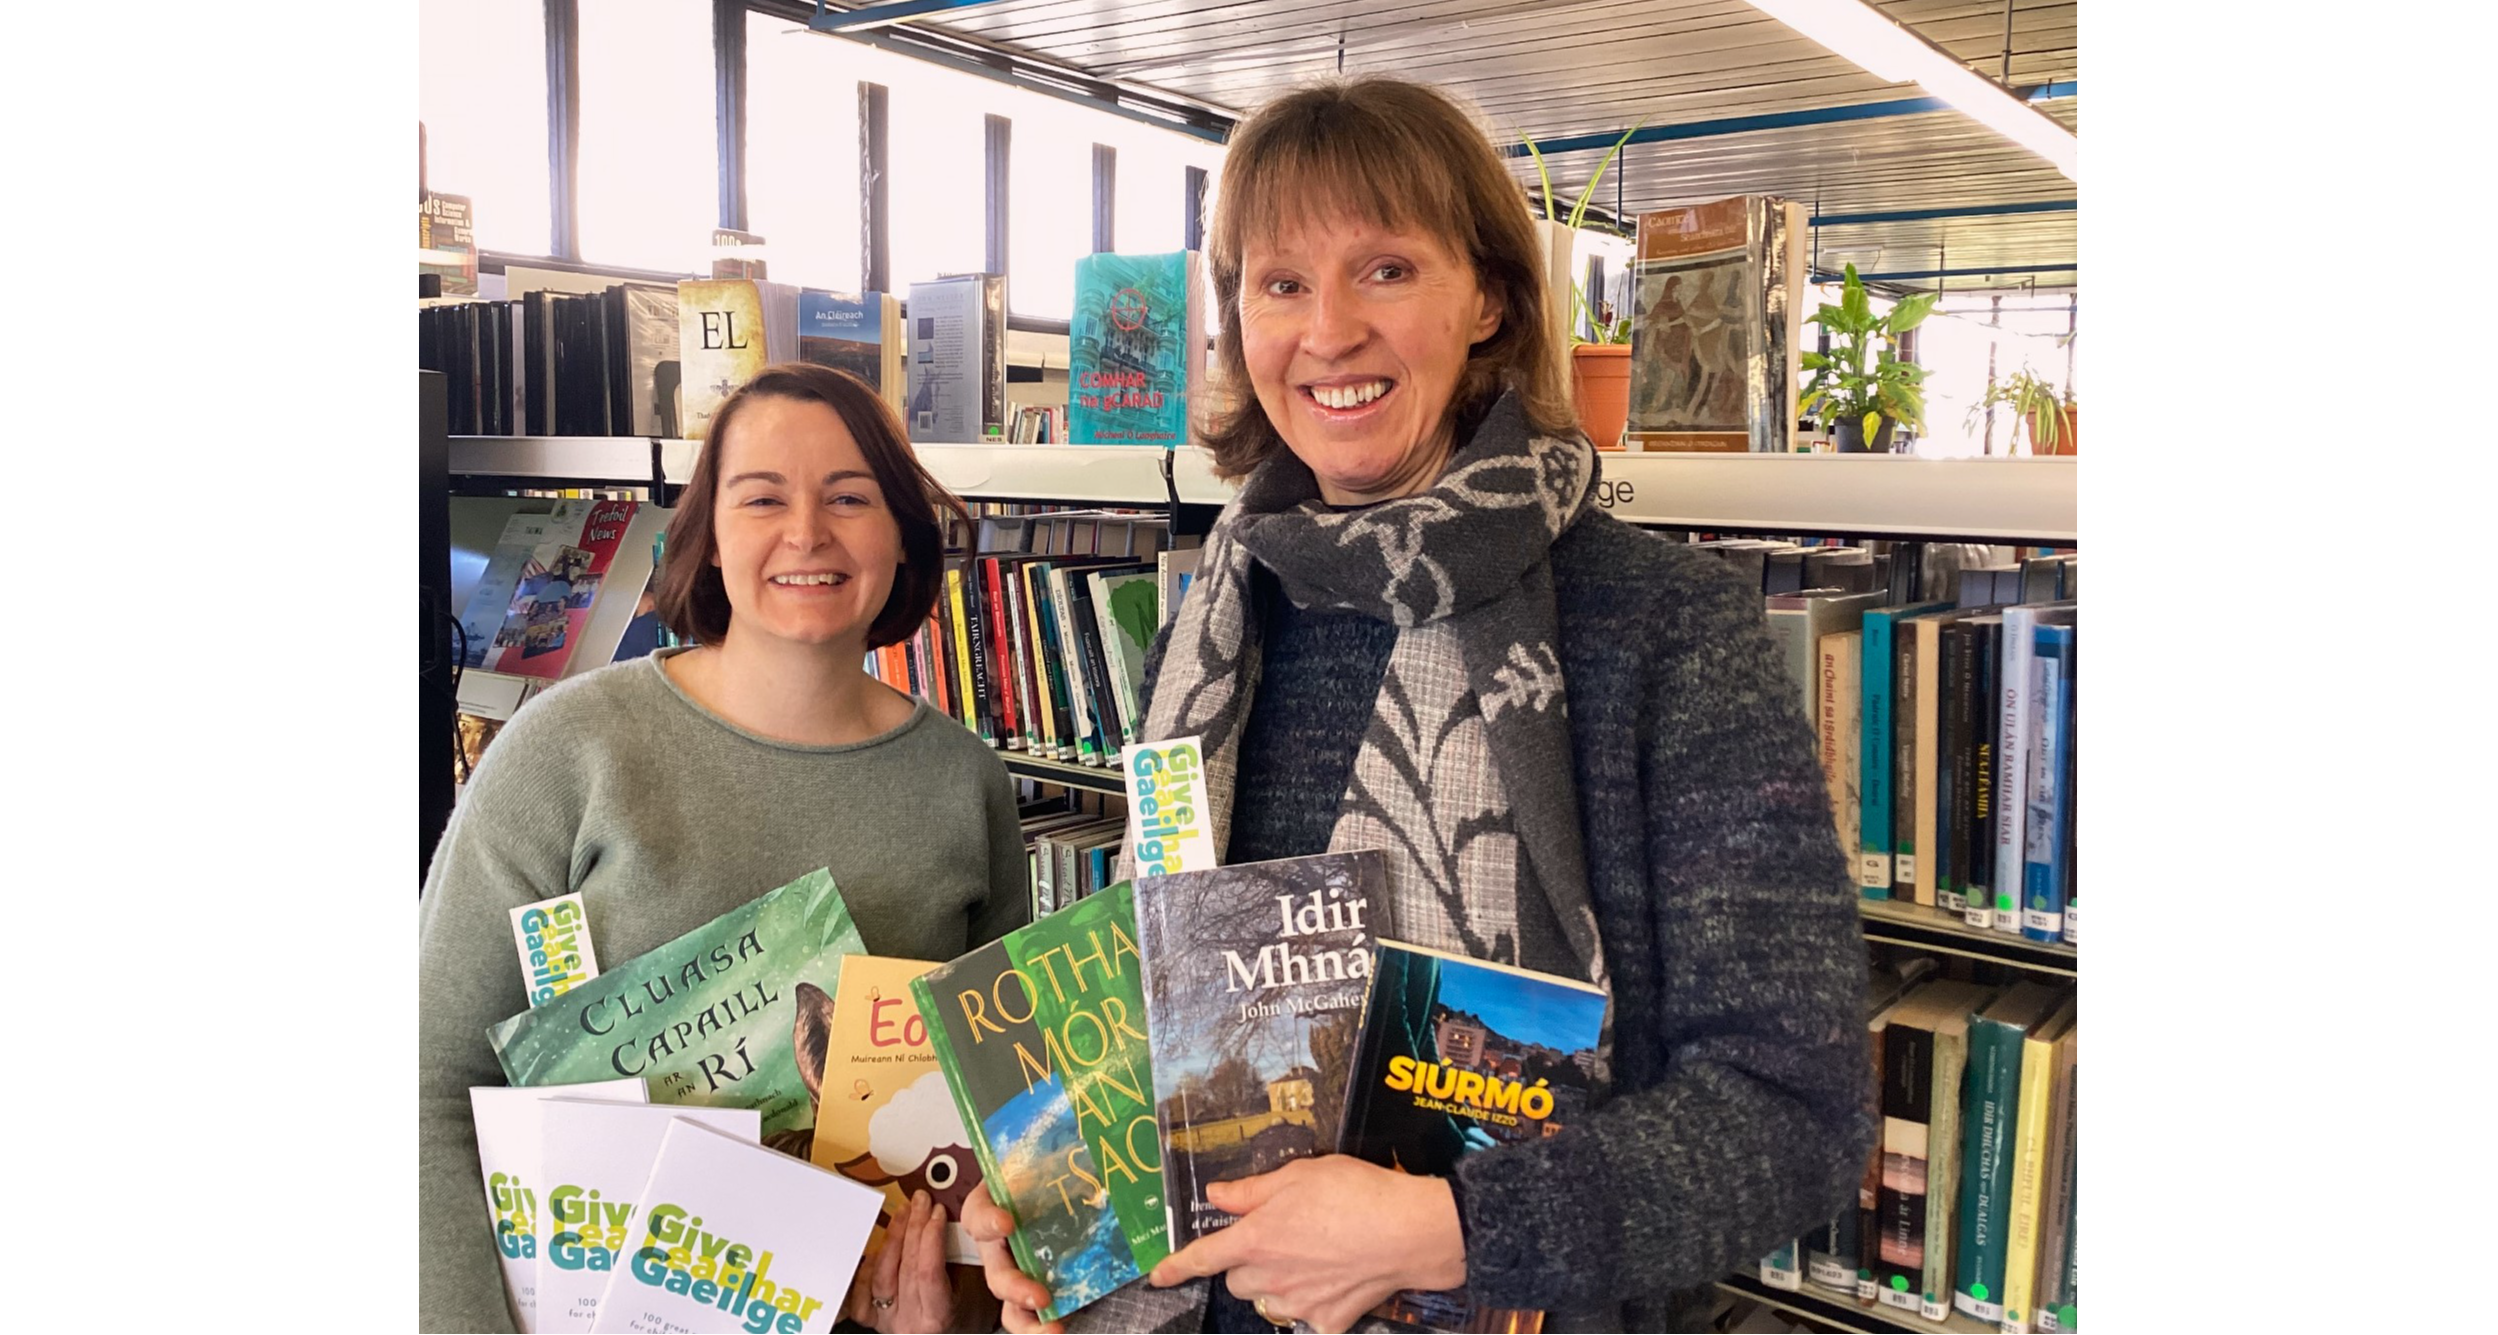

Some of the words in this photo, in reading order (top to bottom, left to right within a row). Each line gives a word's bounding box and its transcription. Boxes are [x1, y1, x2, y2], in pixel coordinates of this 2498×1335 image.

[698, 311, 748, 350] EL
[1079, 371, 1146, 389] COMHAR
[1080, 395, 1099, 408] na
[1103, 391, 1164, 412] gCARAD
[587, 526, 617, 544] News
[591, 503, 630, 526] Trefoil
[970, 614, 986, 700] TAIRNGREACHT
[1168, 743, 1199, 826] Give
[2001, 754, 2015, 812] RAMHAR
[1133, 749, 1179, 877] Gaeilge
[1150, 748, 1200, 874] Leabha
[2000, 814, 2012, 846] SIAR
[553, 900, 583, 972] Give
[1275, 888, 1367, 937] Idir
[521, 908, 569, 1007] Gaeilg
[580, 927, 765, 1036] CLUASA
[958, 920, 1140, 1044] ROTHA
[1222, 933, 1371, 993] Mhná
[611, 980, 779, 1077] CAPAILL
[870, 998, 928, 1048] Eo
[1238, 1001, 1281, 1024] John
[697, 1036, 756, 1095] RÍ
[851, 1054, 892, 1063] Muireann
[1013, 996, 1148, 1095] MÓR
[664, 1071, 683, 1088] AR
[677, 1082, 696, 1099] AN
[1073, 1056, 1147, 1140] AN
[1384, 1055, 1554, 1120] SIÚRMÓ
[1413, 1096, 1490, 1121] JEAN-CLAUDE
[1491, 1112, 1518, 1127] IZZO
[1984, 1100, 1995, 1124] IDIR
[489, 1171, 536, 1215] Giv
[548, 1184, 639, 1228] Giv
[647, 1203, 753, 1270] Give
[1975, 1194, 1990, 1246] DUALGAS
[569, 1308, 583, 1318] for
[578, 1298, 597, 1308] 100
[631, 1246, 803, 1334] Gaeilge
[630, 1319, 646, 1332] for
[643, 1312, 663, 1326] 100
[663, 1322, 690, 1334] great
